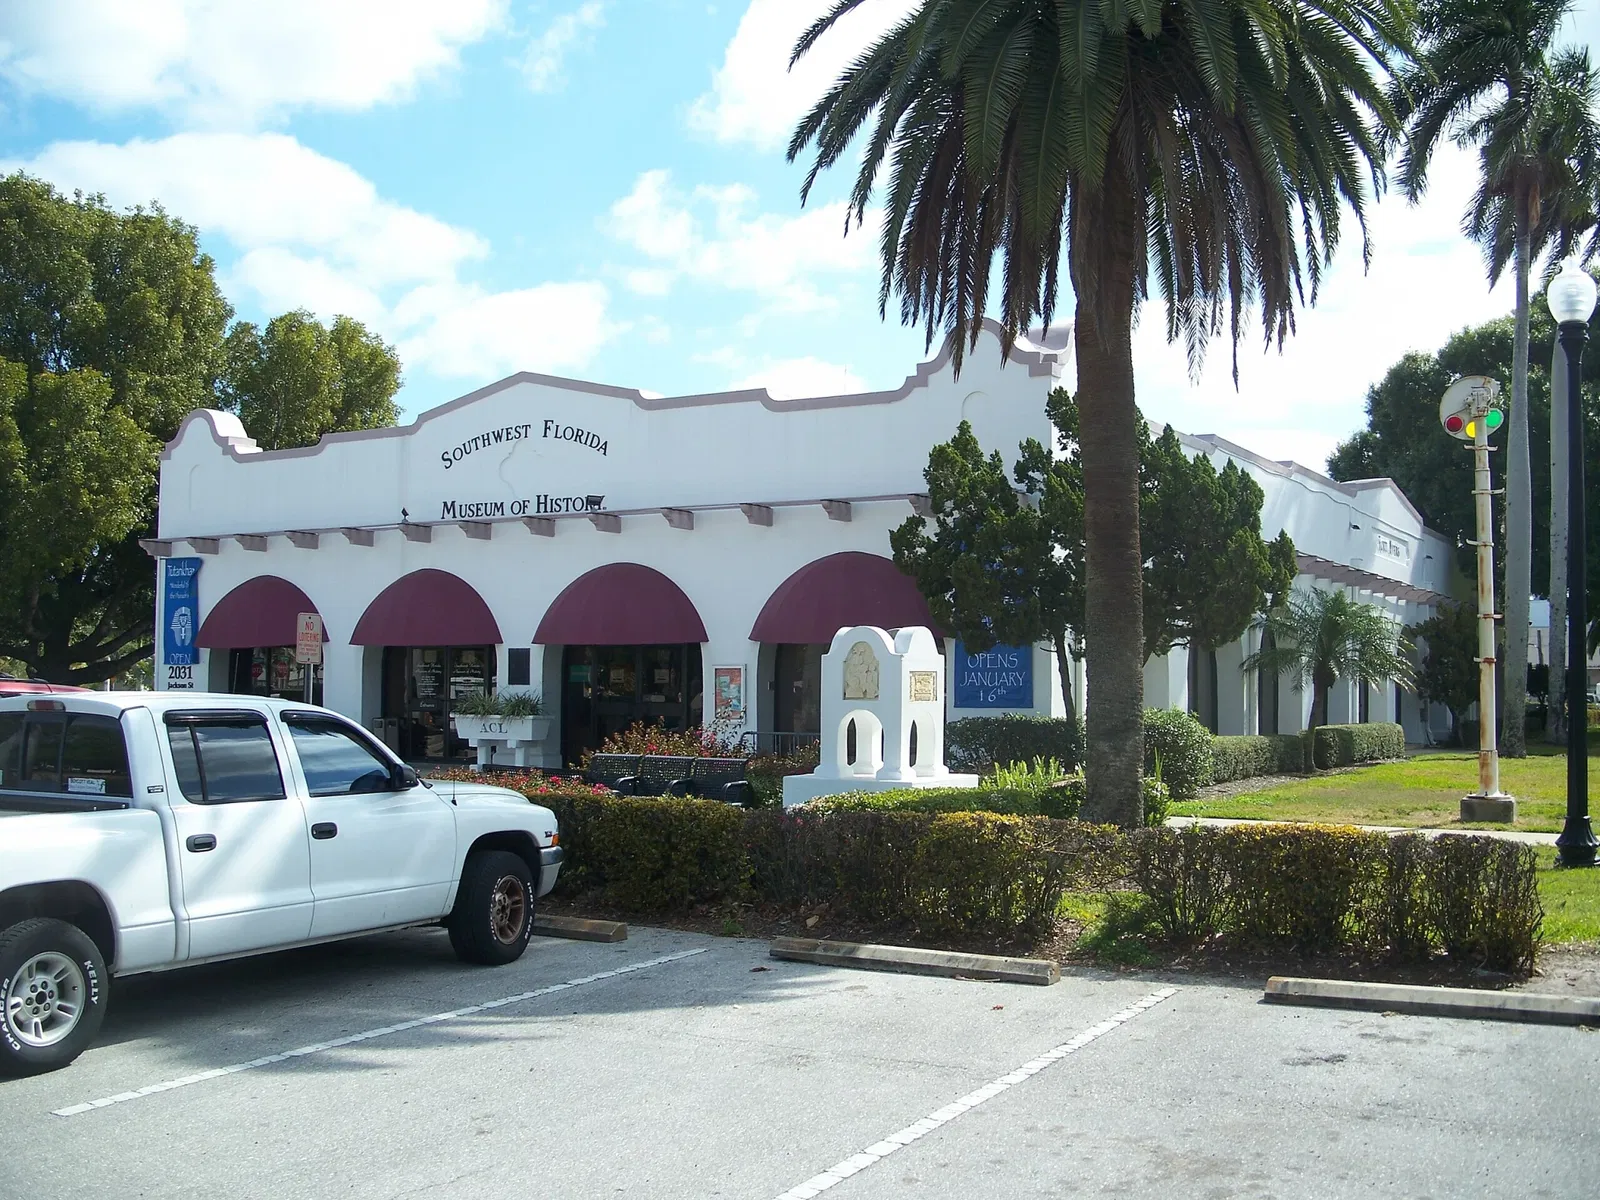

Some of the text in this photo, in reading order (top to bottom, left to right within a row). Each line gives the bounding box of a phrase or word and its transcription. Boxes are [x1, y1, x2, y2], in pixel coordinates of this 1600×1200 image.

[441, 419, 609, 469] SOUTHWEST FLORIDA
[441, 500, 505, 519] MUSEUM
[510, 499, 530, 516] OF
[304, 621, 315, 631] NO
[169, 653, 192, 665] OPEN
[967, 653, 1018, 668] OPENS
[168, 665, 193, 680] 2031
[960, 671, 1026, 687] JANUARY
[480, 722, 508, 734] ACL
[83, 960, 98, 1005] KELLY
